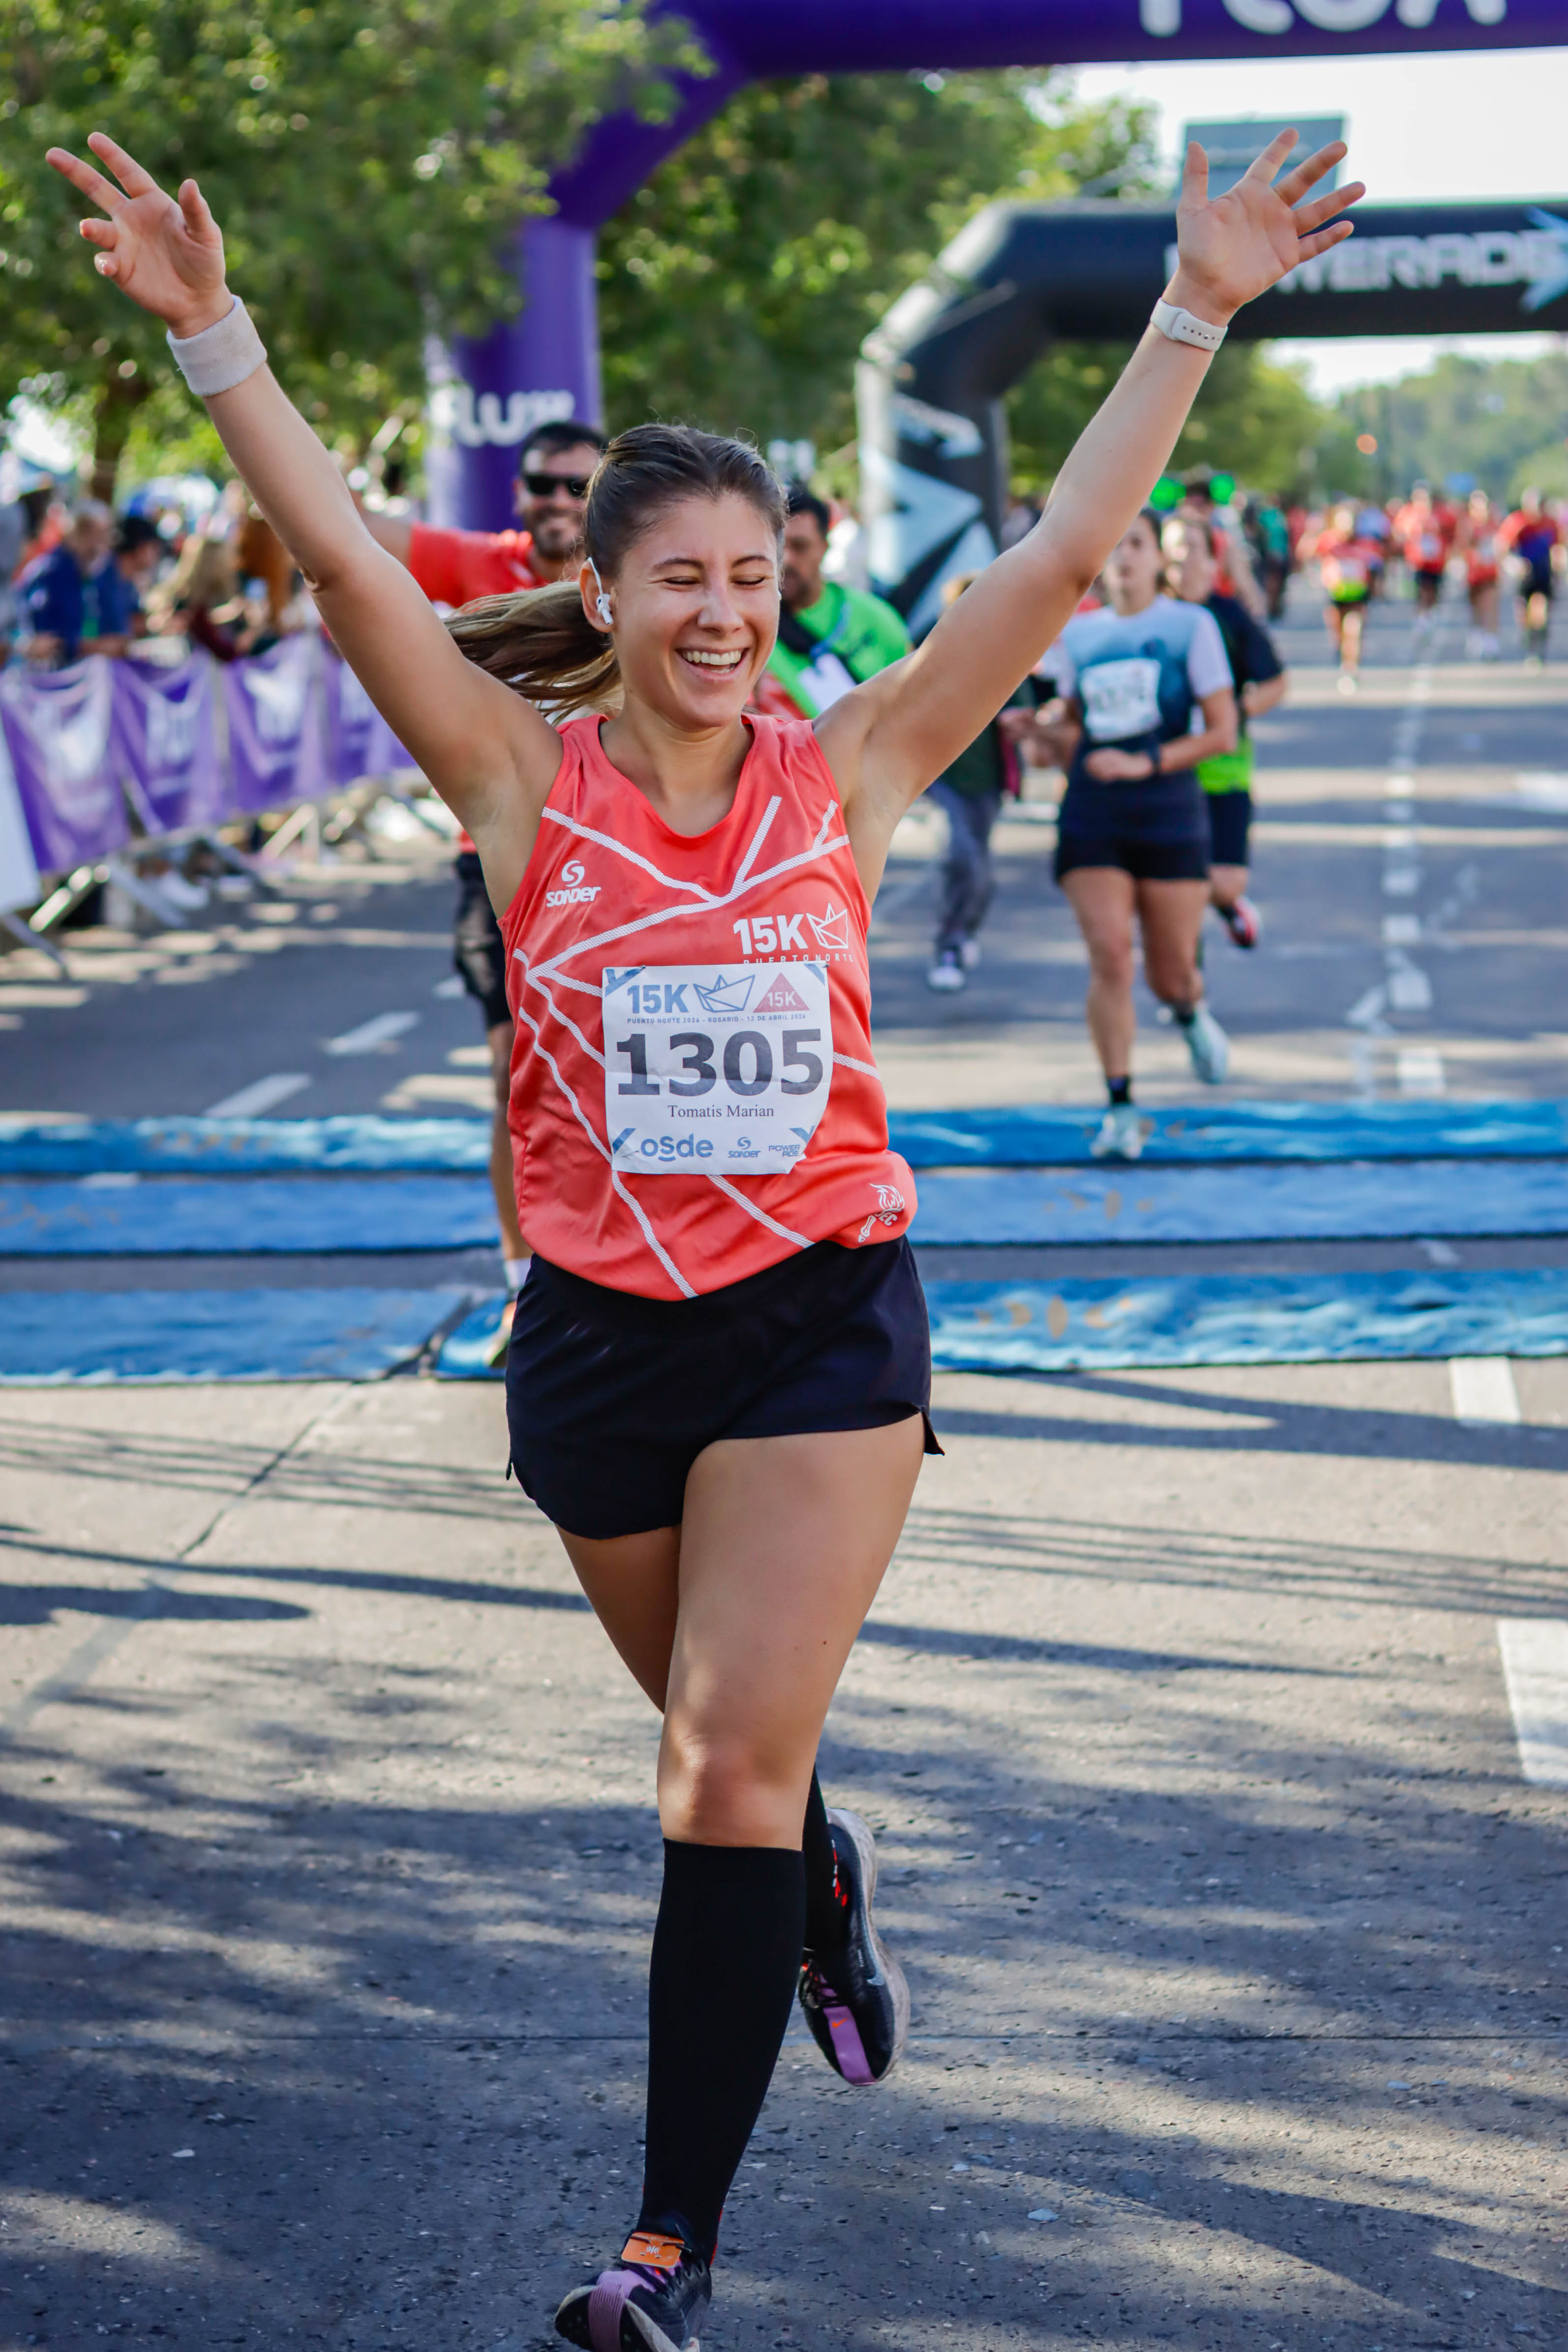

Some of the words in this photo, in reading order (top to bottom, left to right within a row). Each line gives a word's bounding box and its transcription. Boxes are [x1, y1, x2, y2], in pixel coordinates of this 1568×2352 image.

[733, 914, 808, 955] 15K
[627, 984, 689, 1014] 15K
[767, 991, 796, 1007] 15K
[617, 1029, 824, 1096] 1305
[668, 1105, 722, 1117] Tomatis
[727, 1105, 774, 1117] Marian
[641, 1133, 714, 1158] osde
